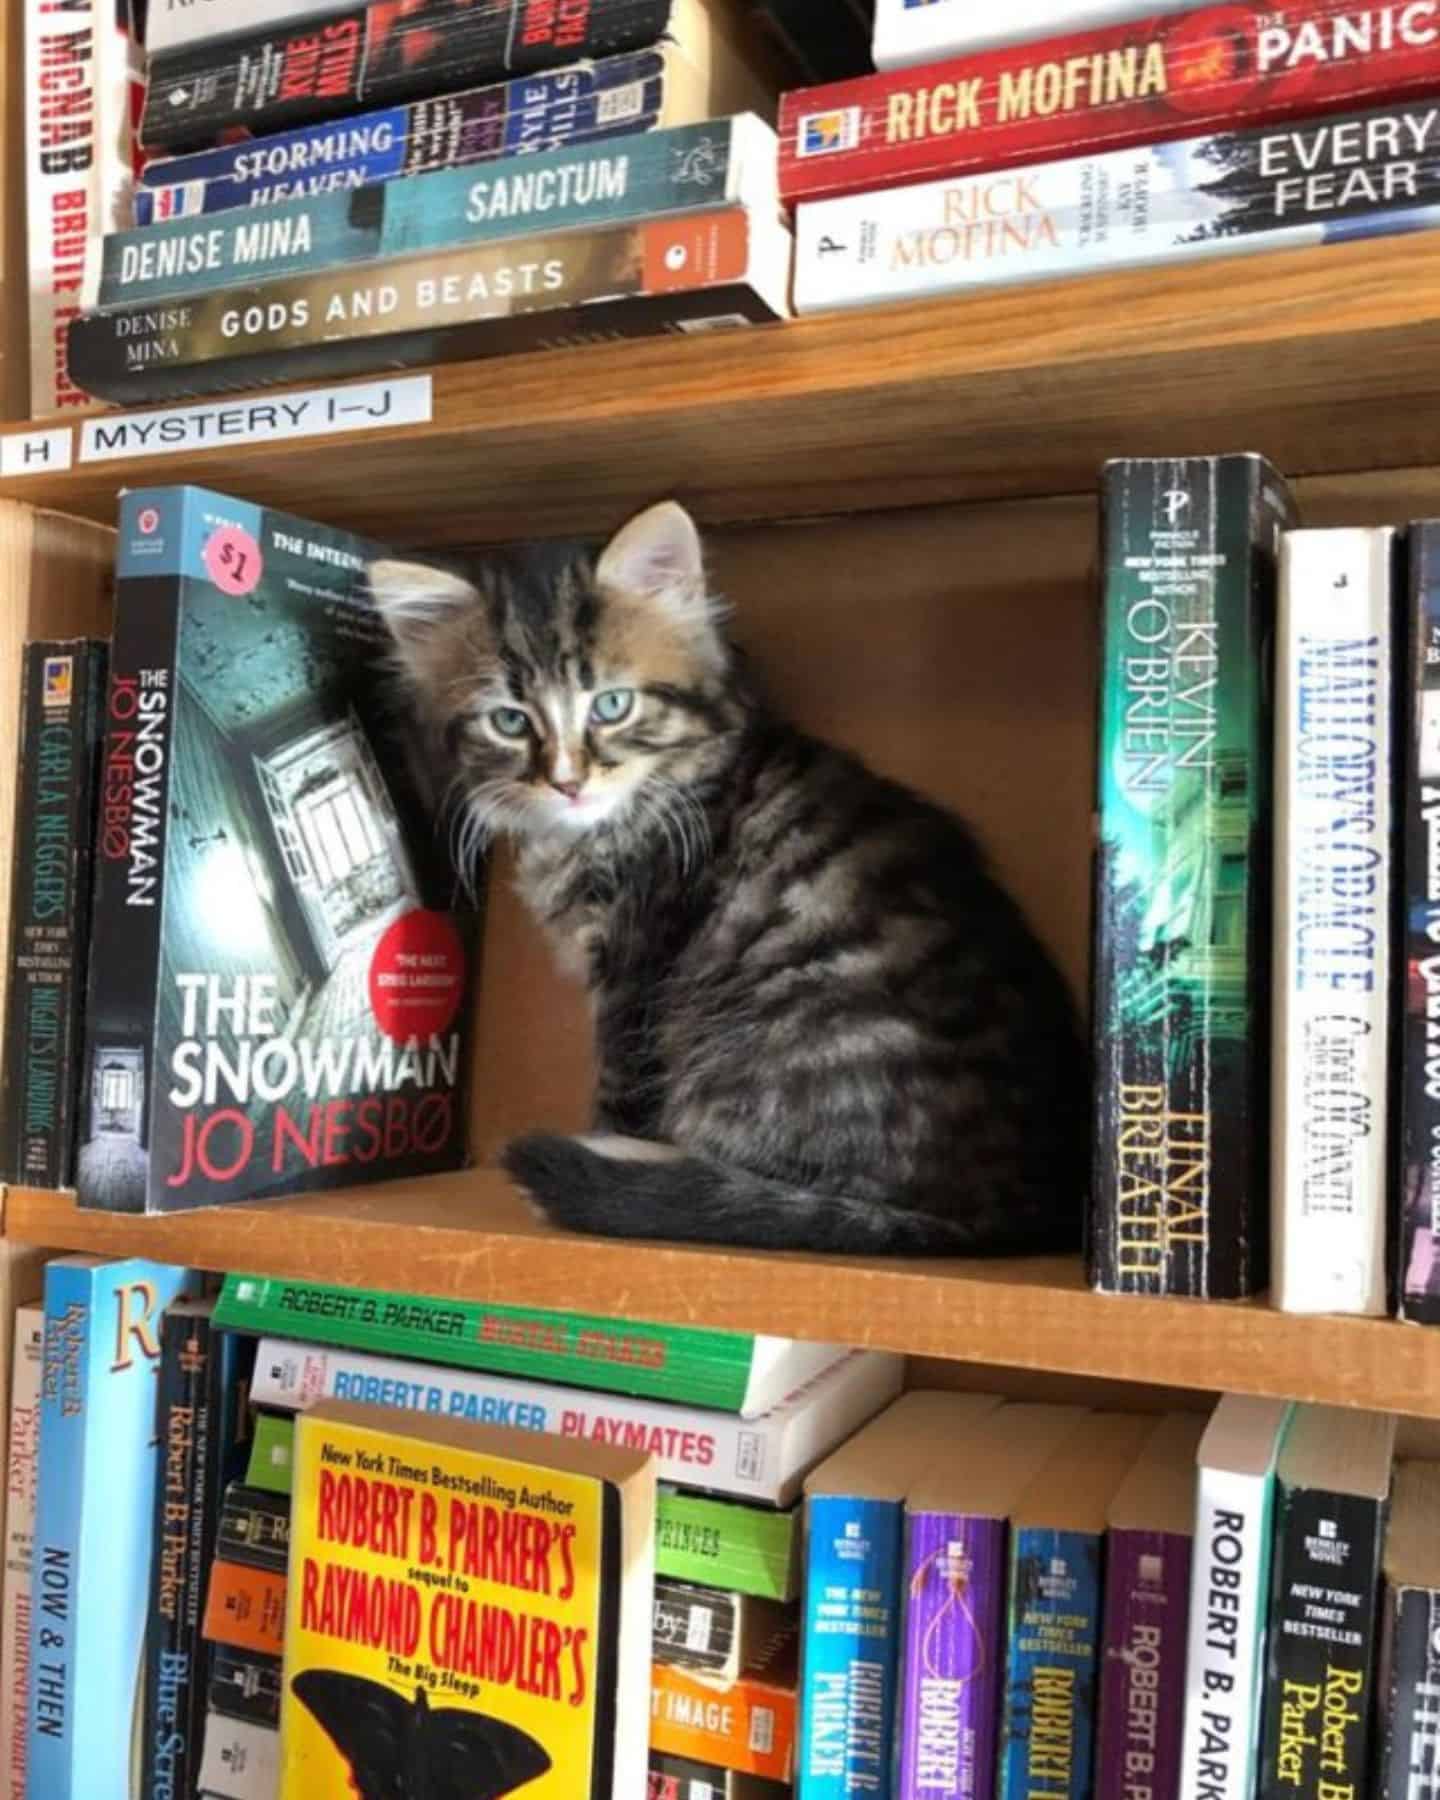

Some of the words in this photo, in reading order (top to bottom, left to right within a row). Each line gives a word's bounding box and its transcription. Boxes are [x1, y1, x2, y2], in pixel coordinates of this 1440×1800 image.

[1256, 1, 1438, 73] PANIC
[885, 77, 983, 144] RICK
[996, 42, 1168, 123] MOFINA
[232, 122, 393, 183] STORMING
[1258, 109, 1439, 178] EVERY
[249, 166, 369, 209] HEAVEN
[466, 156, 629, 223] SANCTUM
[942, 174, 1041, 224] RICK
[1275, 161, 1418, 216] FEAR
[51, 189, 87, 293] BRUTE
[121, 230, 225, 285] DENISE
[233, 214, 312, 266] MINA
[115, 307, 192, 338] DENISE
[220, 300, 310, 337] GODS
[325, 287, 398, 322] AND
[416, 260, 564, 308] BEASTS
[126, 344, 180, 364] MINA
[23, 440, 50, 463] H
[94, 401, 309, 450] MYSTERY
[218, 541, 248, 583] $1
[271, 530, 305, 555] THE
[109, 673, 138, 721] JO
[138, 669, 169, 688] THE
[1124, 598, 1172, 793] O'BRIEN
[1173, 622, 1219, 768] KEVIN
[39, 724, 72, 804] CARLA
[103, 731, 137, 860] NESBØ
[125, 691, 168, 907] SNOWMAN
[33, 815, 68, 919] NEGGERS
[175, 973, 275, 1037] THE
[168, 1033, 460, 1108] SNOWMAN
[166, 1107, 255, 1187] JO
[271, 1093, 451, 1173] NESBØ
[1118, 1084, 1167, 1275] BREATH
[1166, 1110, 1209, 1245] FINAL
[280, 1286, 356, 1317] ROBERT
[382, 1303, 466, 1337] PARKER
[9, 1407, 33, 1497] Parker
[165, 1404, 194, 1494] Robert
[333, 1370, 423, 1409] ROBERT
[449, 1390, 547, 1433] PARKER
[560, 1411, 717, 1467] PLAYMATES
[163, 1500, 189, 1526] B.
[320, 1443, 352, 1466] New
[355, 1448, 384, 1474] York
[387, 1456, 430, 1484] Times
[432, 1466, 516, 1509] Bestselling
[519, 1487, 575, 1515] Author
[317, 1468, 414, 1560] ROBERT
[419, 1491, 444, 1568] B.
[450, 1497, 577, 1601] PARKER'S
[41, 1547, 71, 1621] NOW
[159, 1534, 189, 1622] Parker
[408, 1567, 452, 1589] sequel
[455, 1575, 470, 1593] to
[1205, 1508, 1245, 1660] ROBERT
[1289, 1583, 1325, 1600] NEW
[1326, 1588, 1362, 1609] YORK
[1304, 1603, 1346, 1624] TIMES
[38, 1627, 65, 1650] &
[300, 1557, 422, 1659] RAYMOND
[429, 1591, 588, 1708] CHANDLER'S
[1283, 1619, 1363, 1647] BESTSELLER
[36, 1663, 67, 1739] THEN
[157, 1649, 190, 1727] Blue
[388, 1656, 412, 1678] The
[414, 1663, 438, 1688] Big
[440, 1671, 481, 1699] Sleep
[847, 1660, 884, 1766] ROBERT
[1128, 1624, 1162, 1743] ROBERT
[1200, 1667, 1236, 1701] B.
[666, 1694, 734, 1735] IMAGE
[810, 1671, 849, 1777] PARKER
[916, 1678, 962, 1794] ROBERT
[1028, 1666, 1076, 1784] ROBERT
[1277, 1679, 1322, 1786] Parker
[1320, 1664, 1363, 1774] Robert
[1123, 1782, 1152, 1800] P
[1124, 1750, 1156, 1779] B.
